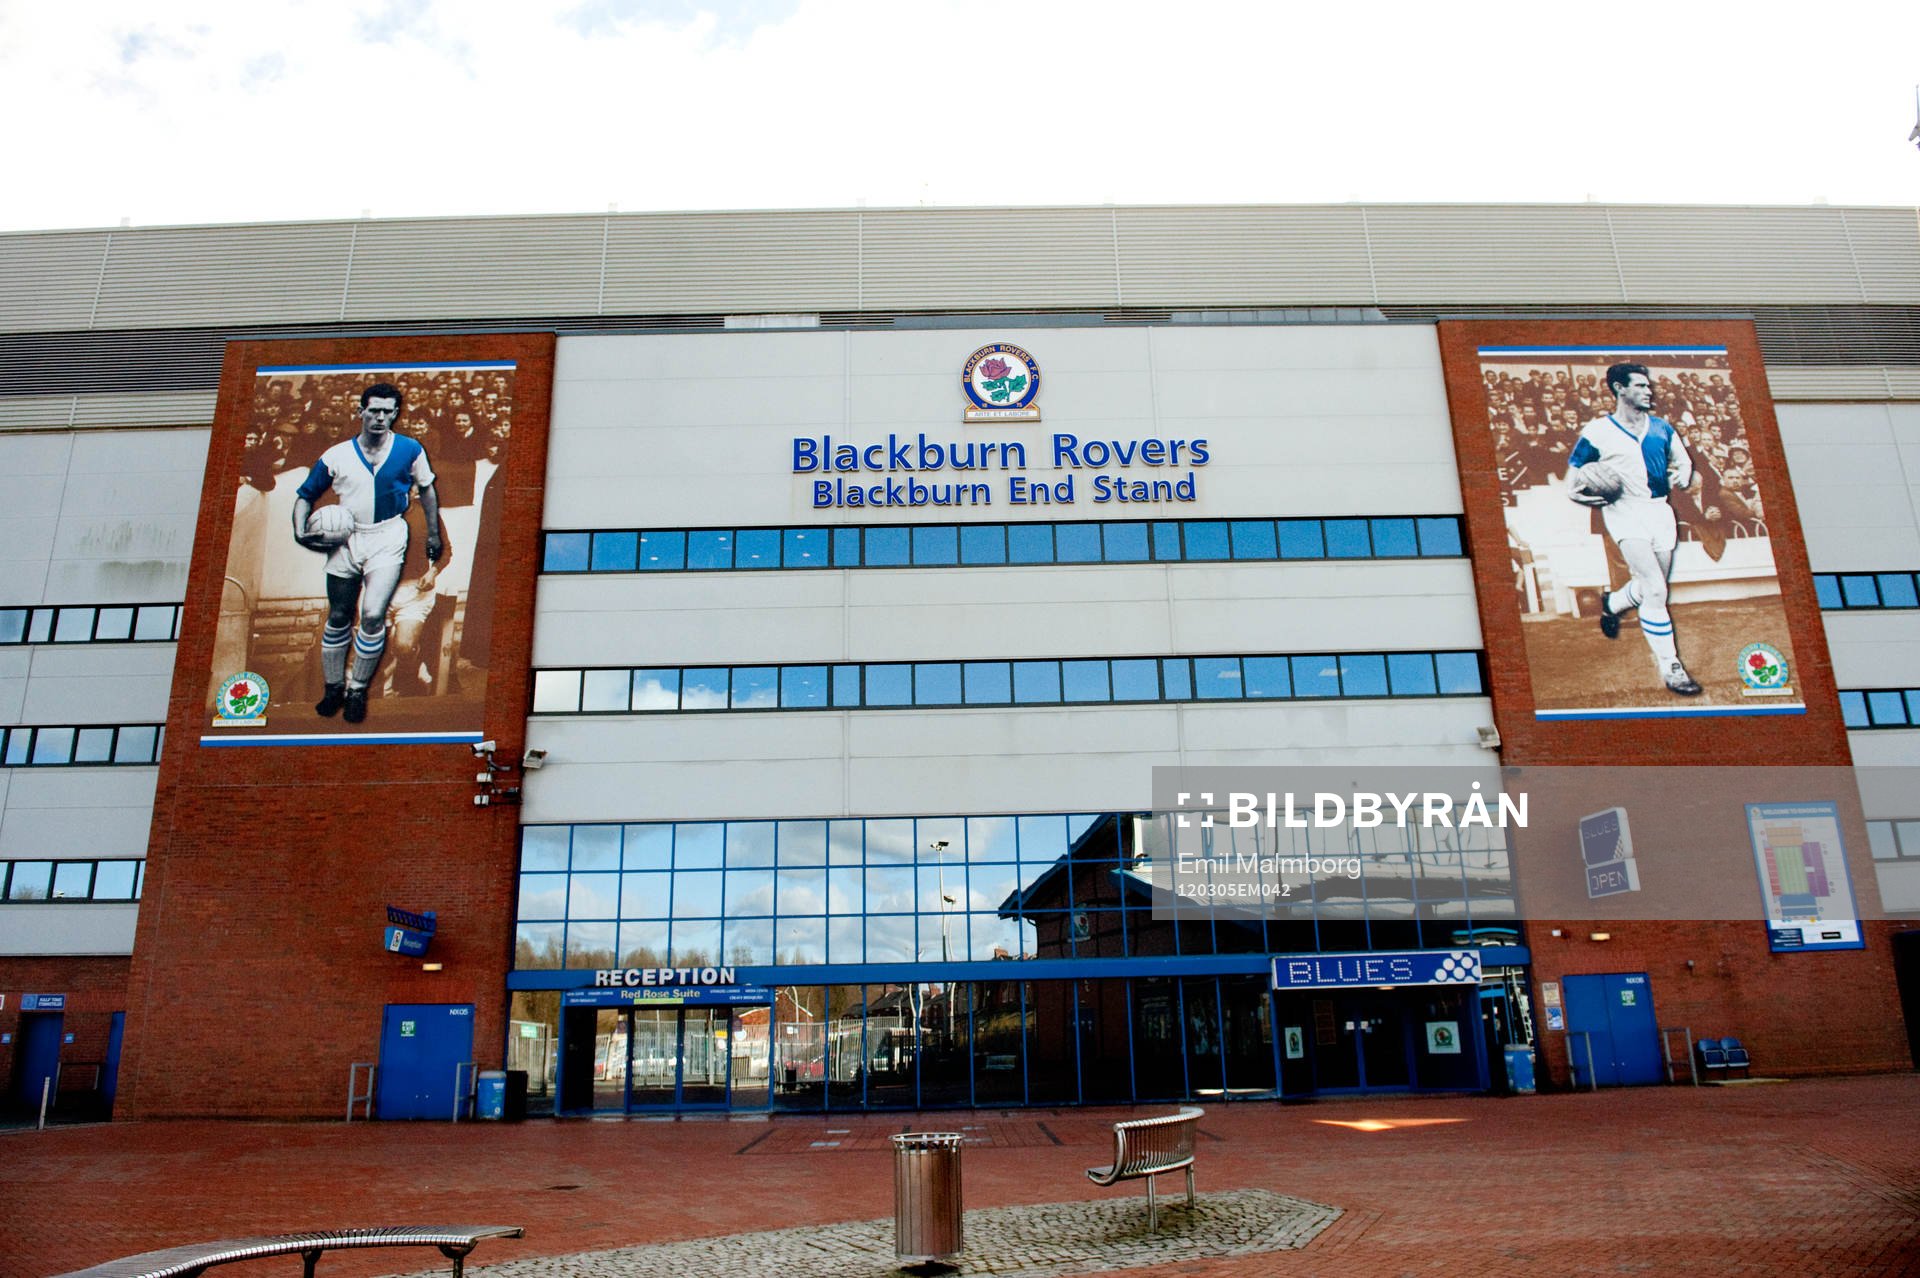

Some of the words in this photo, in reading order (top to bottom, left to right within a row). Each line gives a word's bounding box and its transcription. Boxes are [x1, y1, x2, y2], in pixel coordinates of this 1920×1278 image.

[963, 346, 996, 383] BLACKBURN
[1001, 345, 1030, 362] ROVERS
[792, 433, 1027, 473] Blackburn
[1052, 432, 1210, 468] Rovers
[812, 476, 992, 508] Blackburn
[1009, 474, 1075, 505] End
[1093, 471, 1197, 503] Stand
[595, 967, 736, 987] RECEPTION
[1288, 958, 1414, 984] BLUES
[620, 989, 641, 999] Red
[643, 989, 670, 999] Rose
[672, 988, 701, 998] Suite
